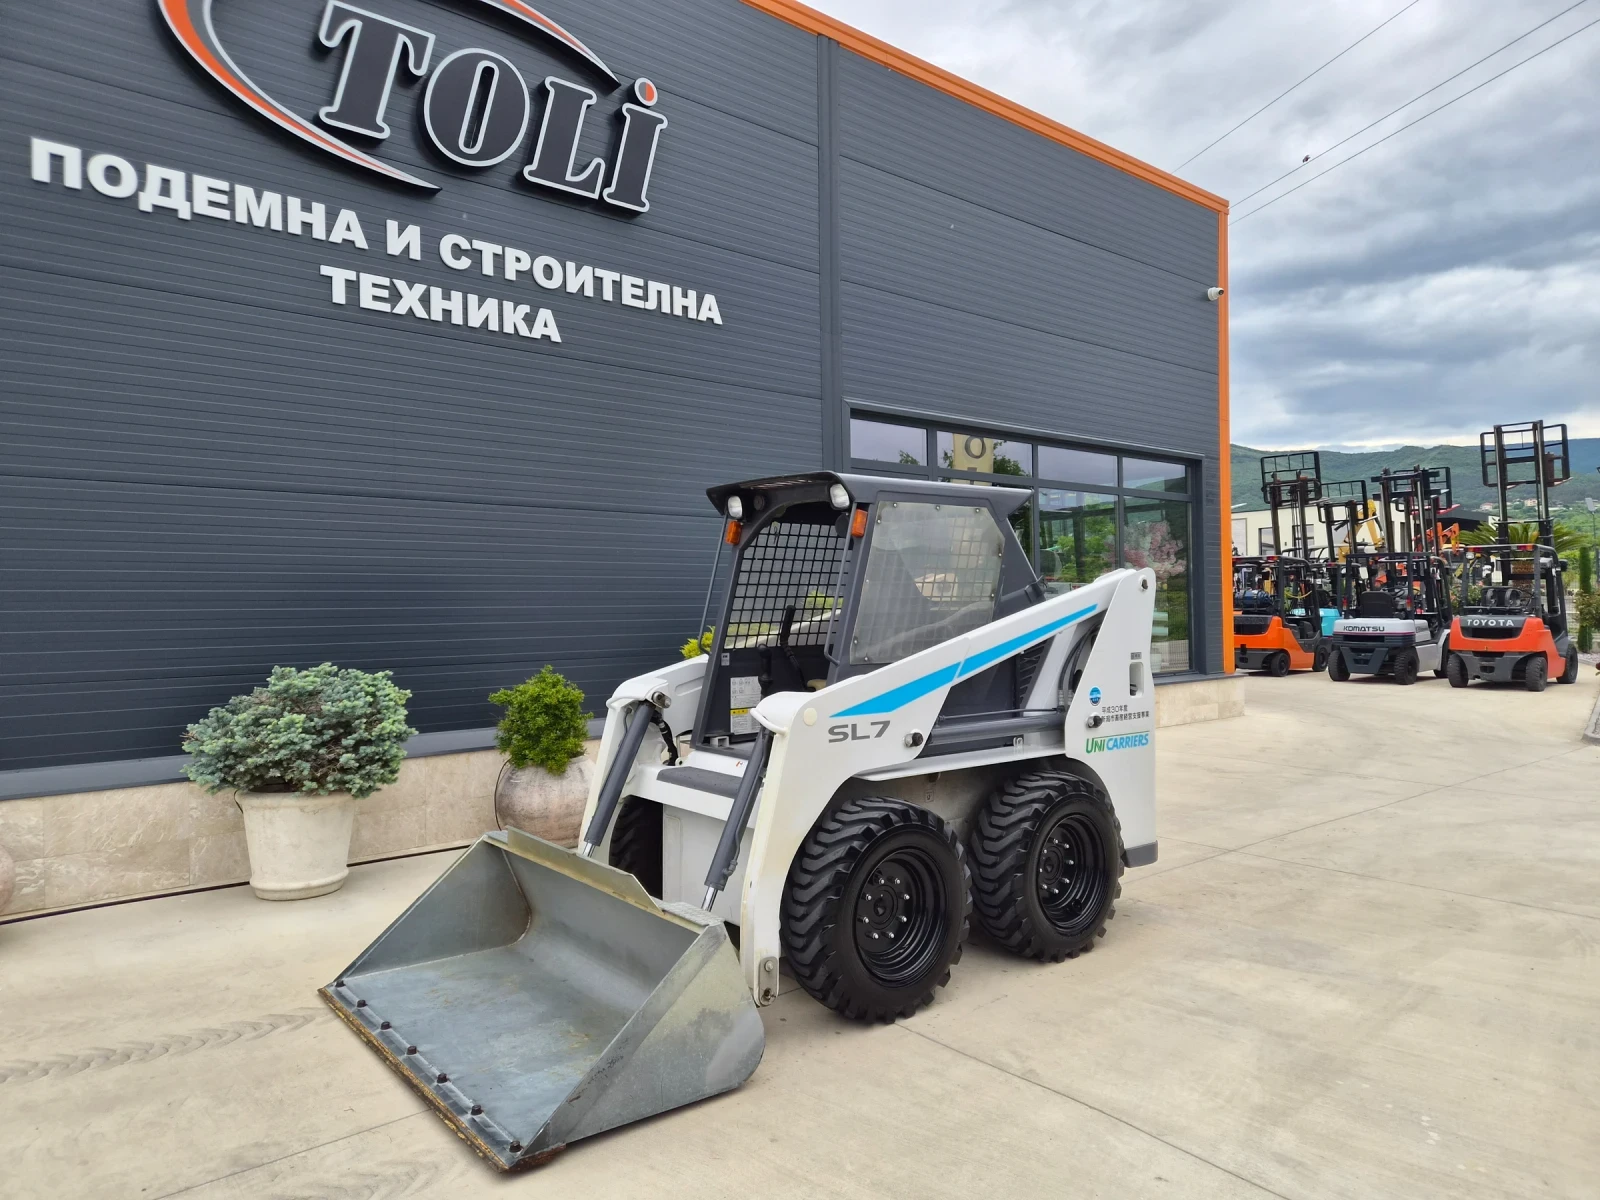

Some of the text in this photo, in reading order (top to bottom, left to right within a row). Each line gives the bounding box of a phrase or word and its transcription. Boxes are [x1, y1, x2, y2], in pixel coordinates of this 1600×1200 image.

[30, 137, 724, 326] ПОДЕМНА И СТРОИТЕЛНА
[319, 264, 563, 344] ТЕХНИКА
[1467, 619, 1515, 627] TOYOTA
[828, 720, 891, 744] SL7
